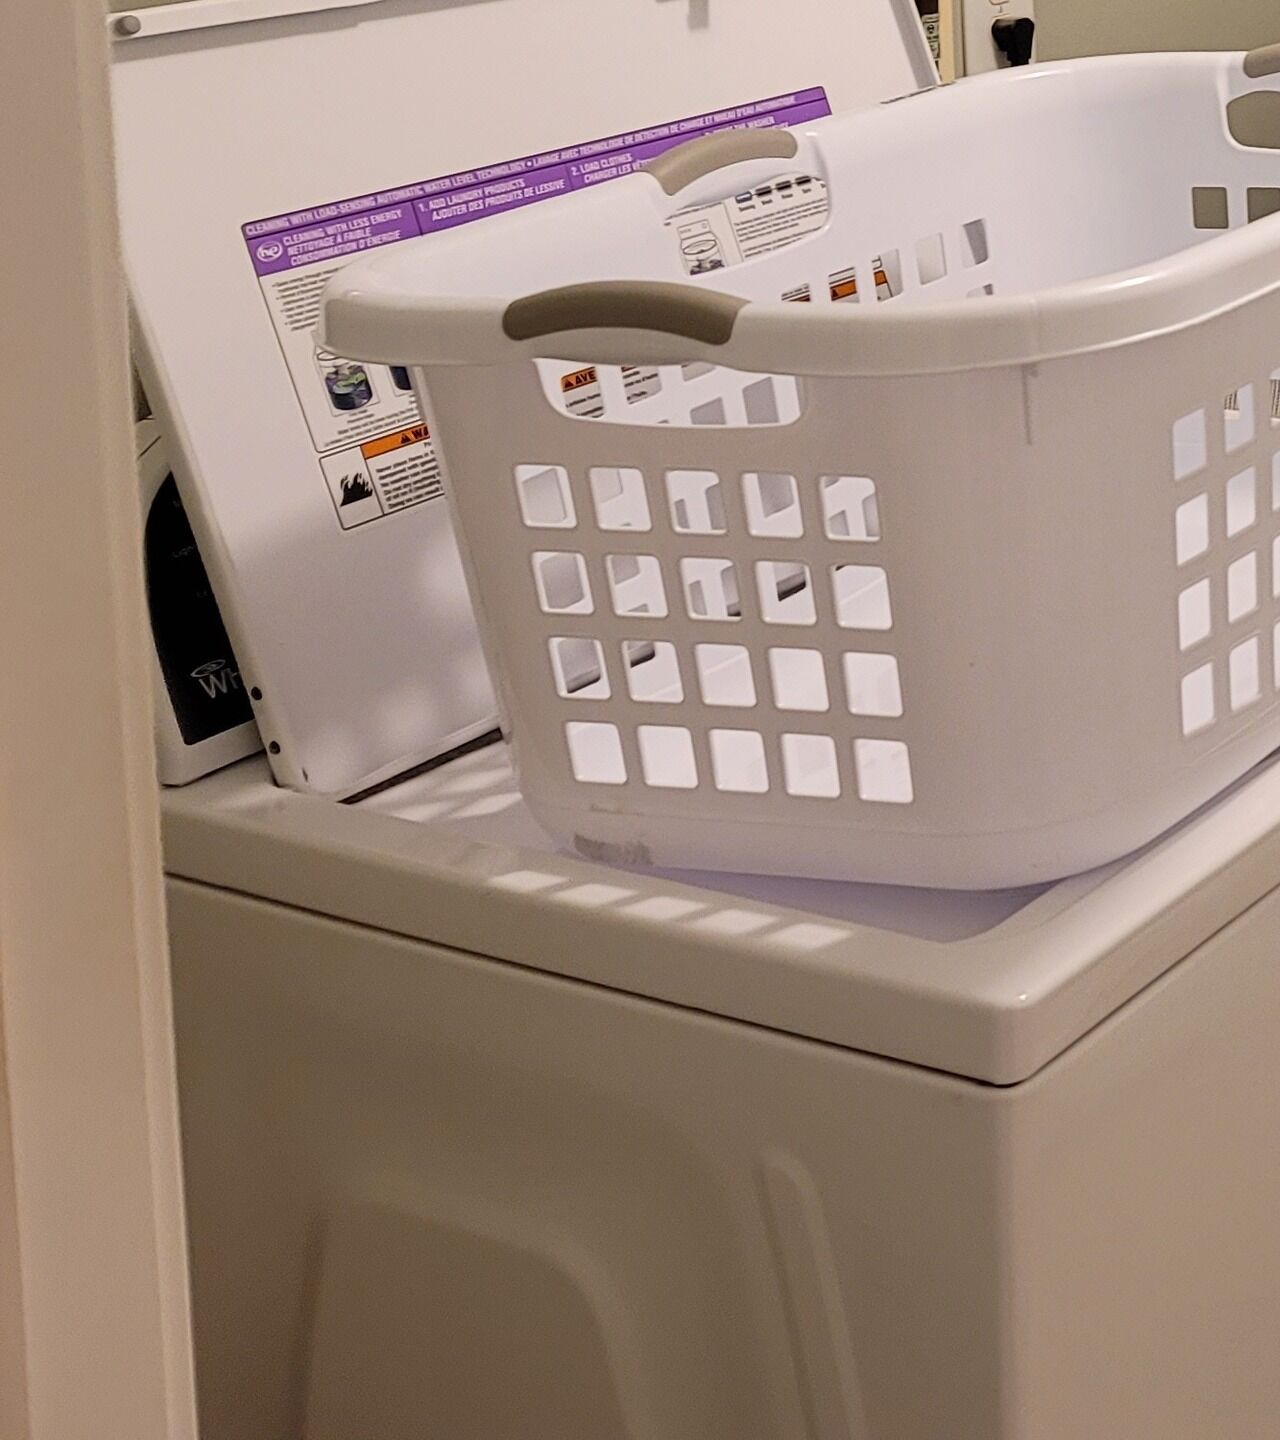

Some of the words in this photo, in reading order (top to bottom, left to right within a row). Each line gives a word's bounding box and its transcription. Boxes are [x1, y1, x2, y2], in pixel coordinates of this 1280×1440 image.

[579, 160, 600, 173] LOAD
[600, 152, 632, 168] CLOTHES
[584, 167, 618, 182] CHARGER
[617, 163, 632, 174] LES
[288, 211, 313, 224] WITH
[452, 173, 474, 185] LEVEL
[428, 197, 445, 209] ADD
[446, 188, 483, 204] LAUNDRY
[483, 178, 525, 196] PRODUCTS
[431, 203, 467, 220] AJOUTER
[467, 199, 484, 211] DES
[483, 189, 523, 207] PRODUITS
[523, 186, 534, 197] DE
[534, 179, 566, 194] LESSIVE
[324, 222, 348, 235] WITH
[348, 216, 369, 229] LESS
[371, 208, 402, 224] ENERGY
[286, 236, 335, 255] NETTOYAGE
[342, 227, 371, 241] FAIBLE
